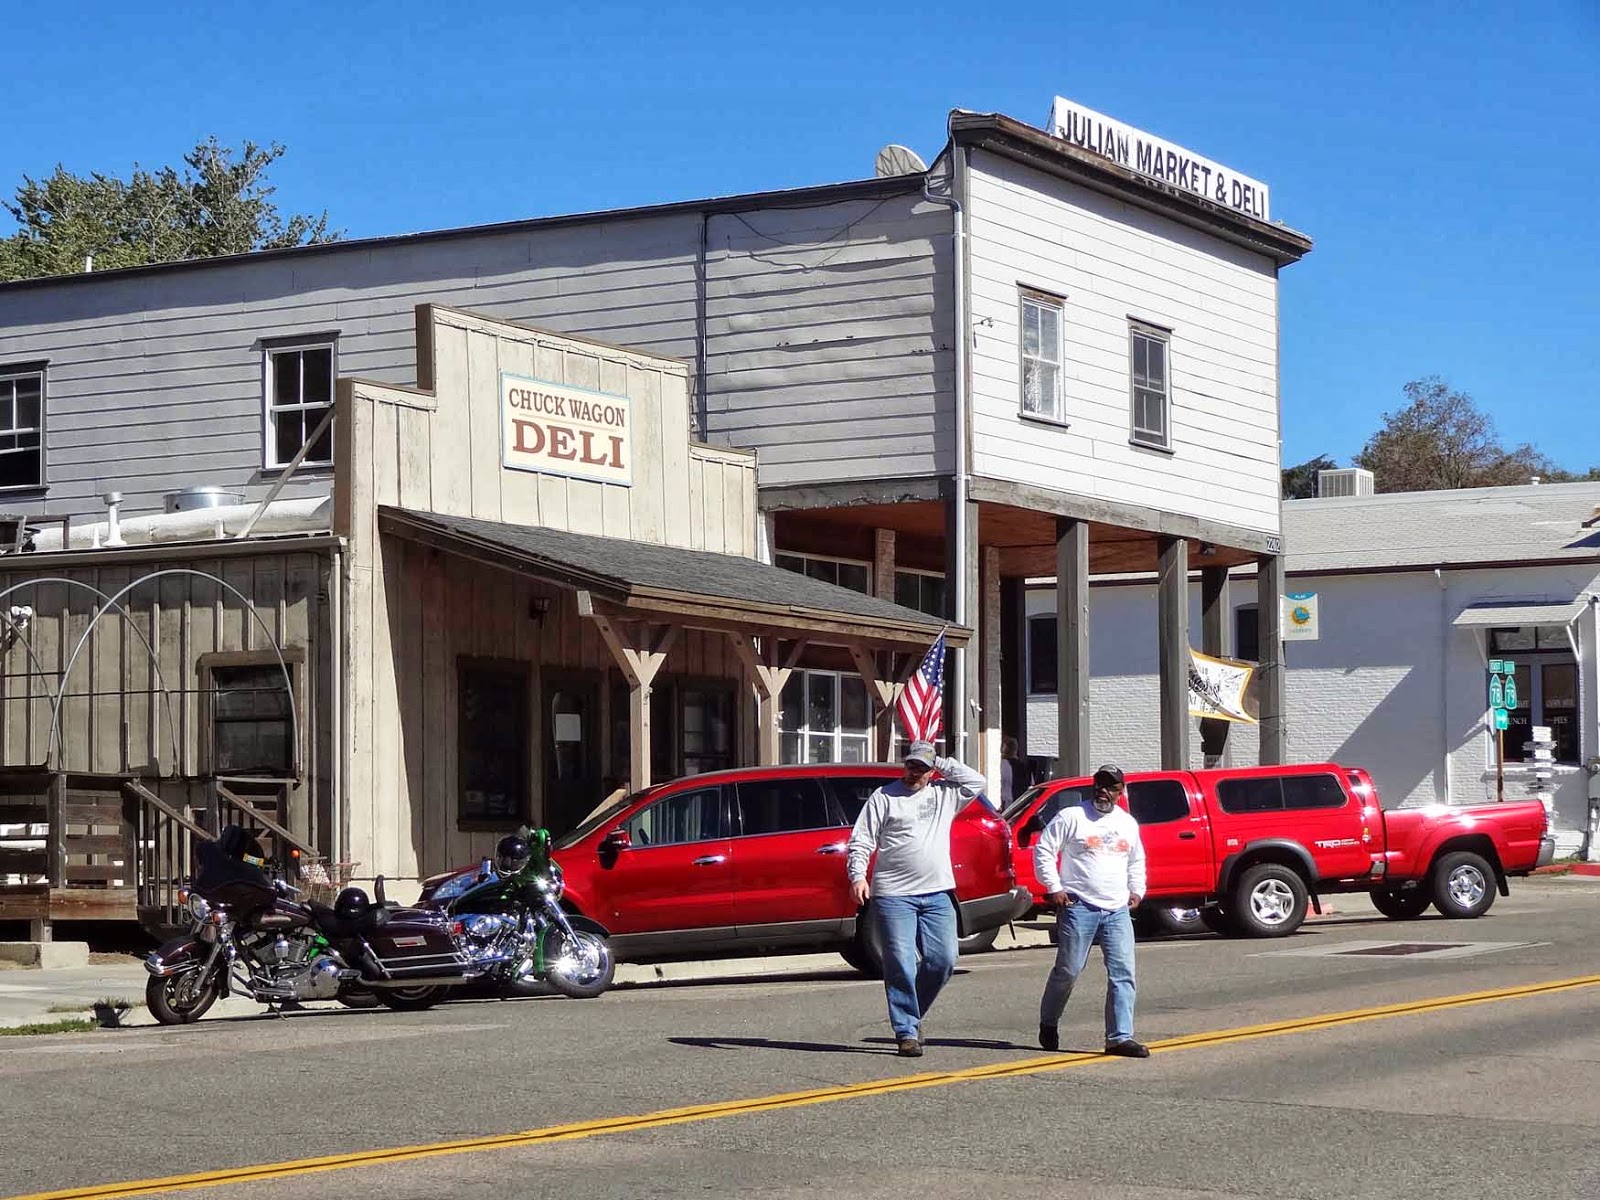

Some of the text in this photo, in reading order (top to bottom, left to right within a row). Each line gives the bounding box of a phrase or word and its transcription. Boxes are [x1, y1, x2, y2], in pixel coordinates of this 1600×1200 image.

[1060, 109, 1266, 219] JULIAN MARKET & DELI
[508, 387, 626, 428] CHUCK WAGON
[511, 418, 625, 470] DELI
[1491, 687, 1501, 704] 78
[1506, 689, 1515, 705] 79
[1314, 840, 1340, 848] TRD
